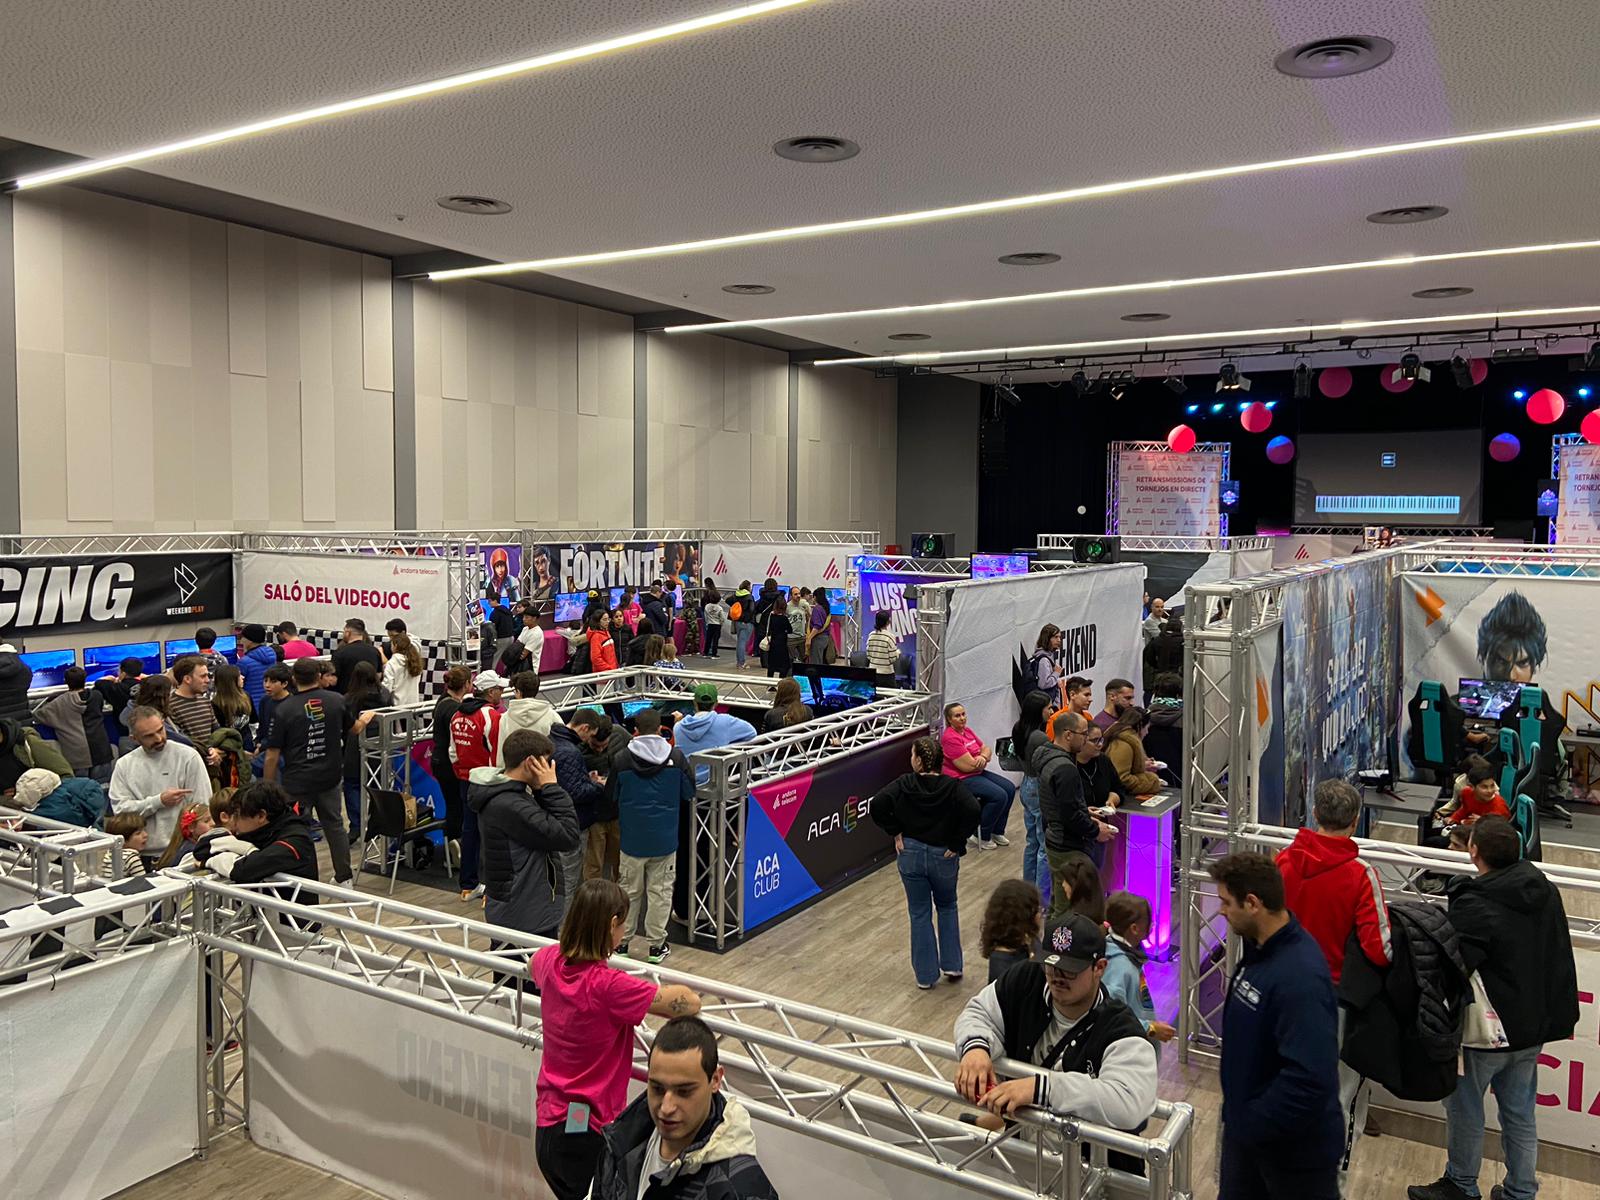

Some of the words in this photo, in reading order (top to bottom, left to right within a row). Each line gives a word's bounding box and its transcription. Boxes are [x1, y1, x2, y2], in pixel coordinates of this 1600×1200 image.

[560, 546, 665, 593] FORTNITE
[264, 579, 302, 602] SALÓ
[305, 585, 332, 604] DEL
[334, 587, 411, 611] VIDEOJOC
[807, 812, 841, 841] ACA
[754, 852, 780, 881] ACA
[754, 872, 780, 899] CLUB
